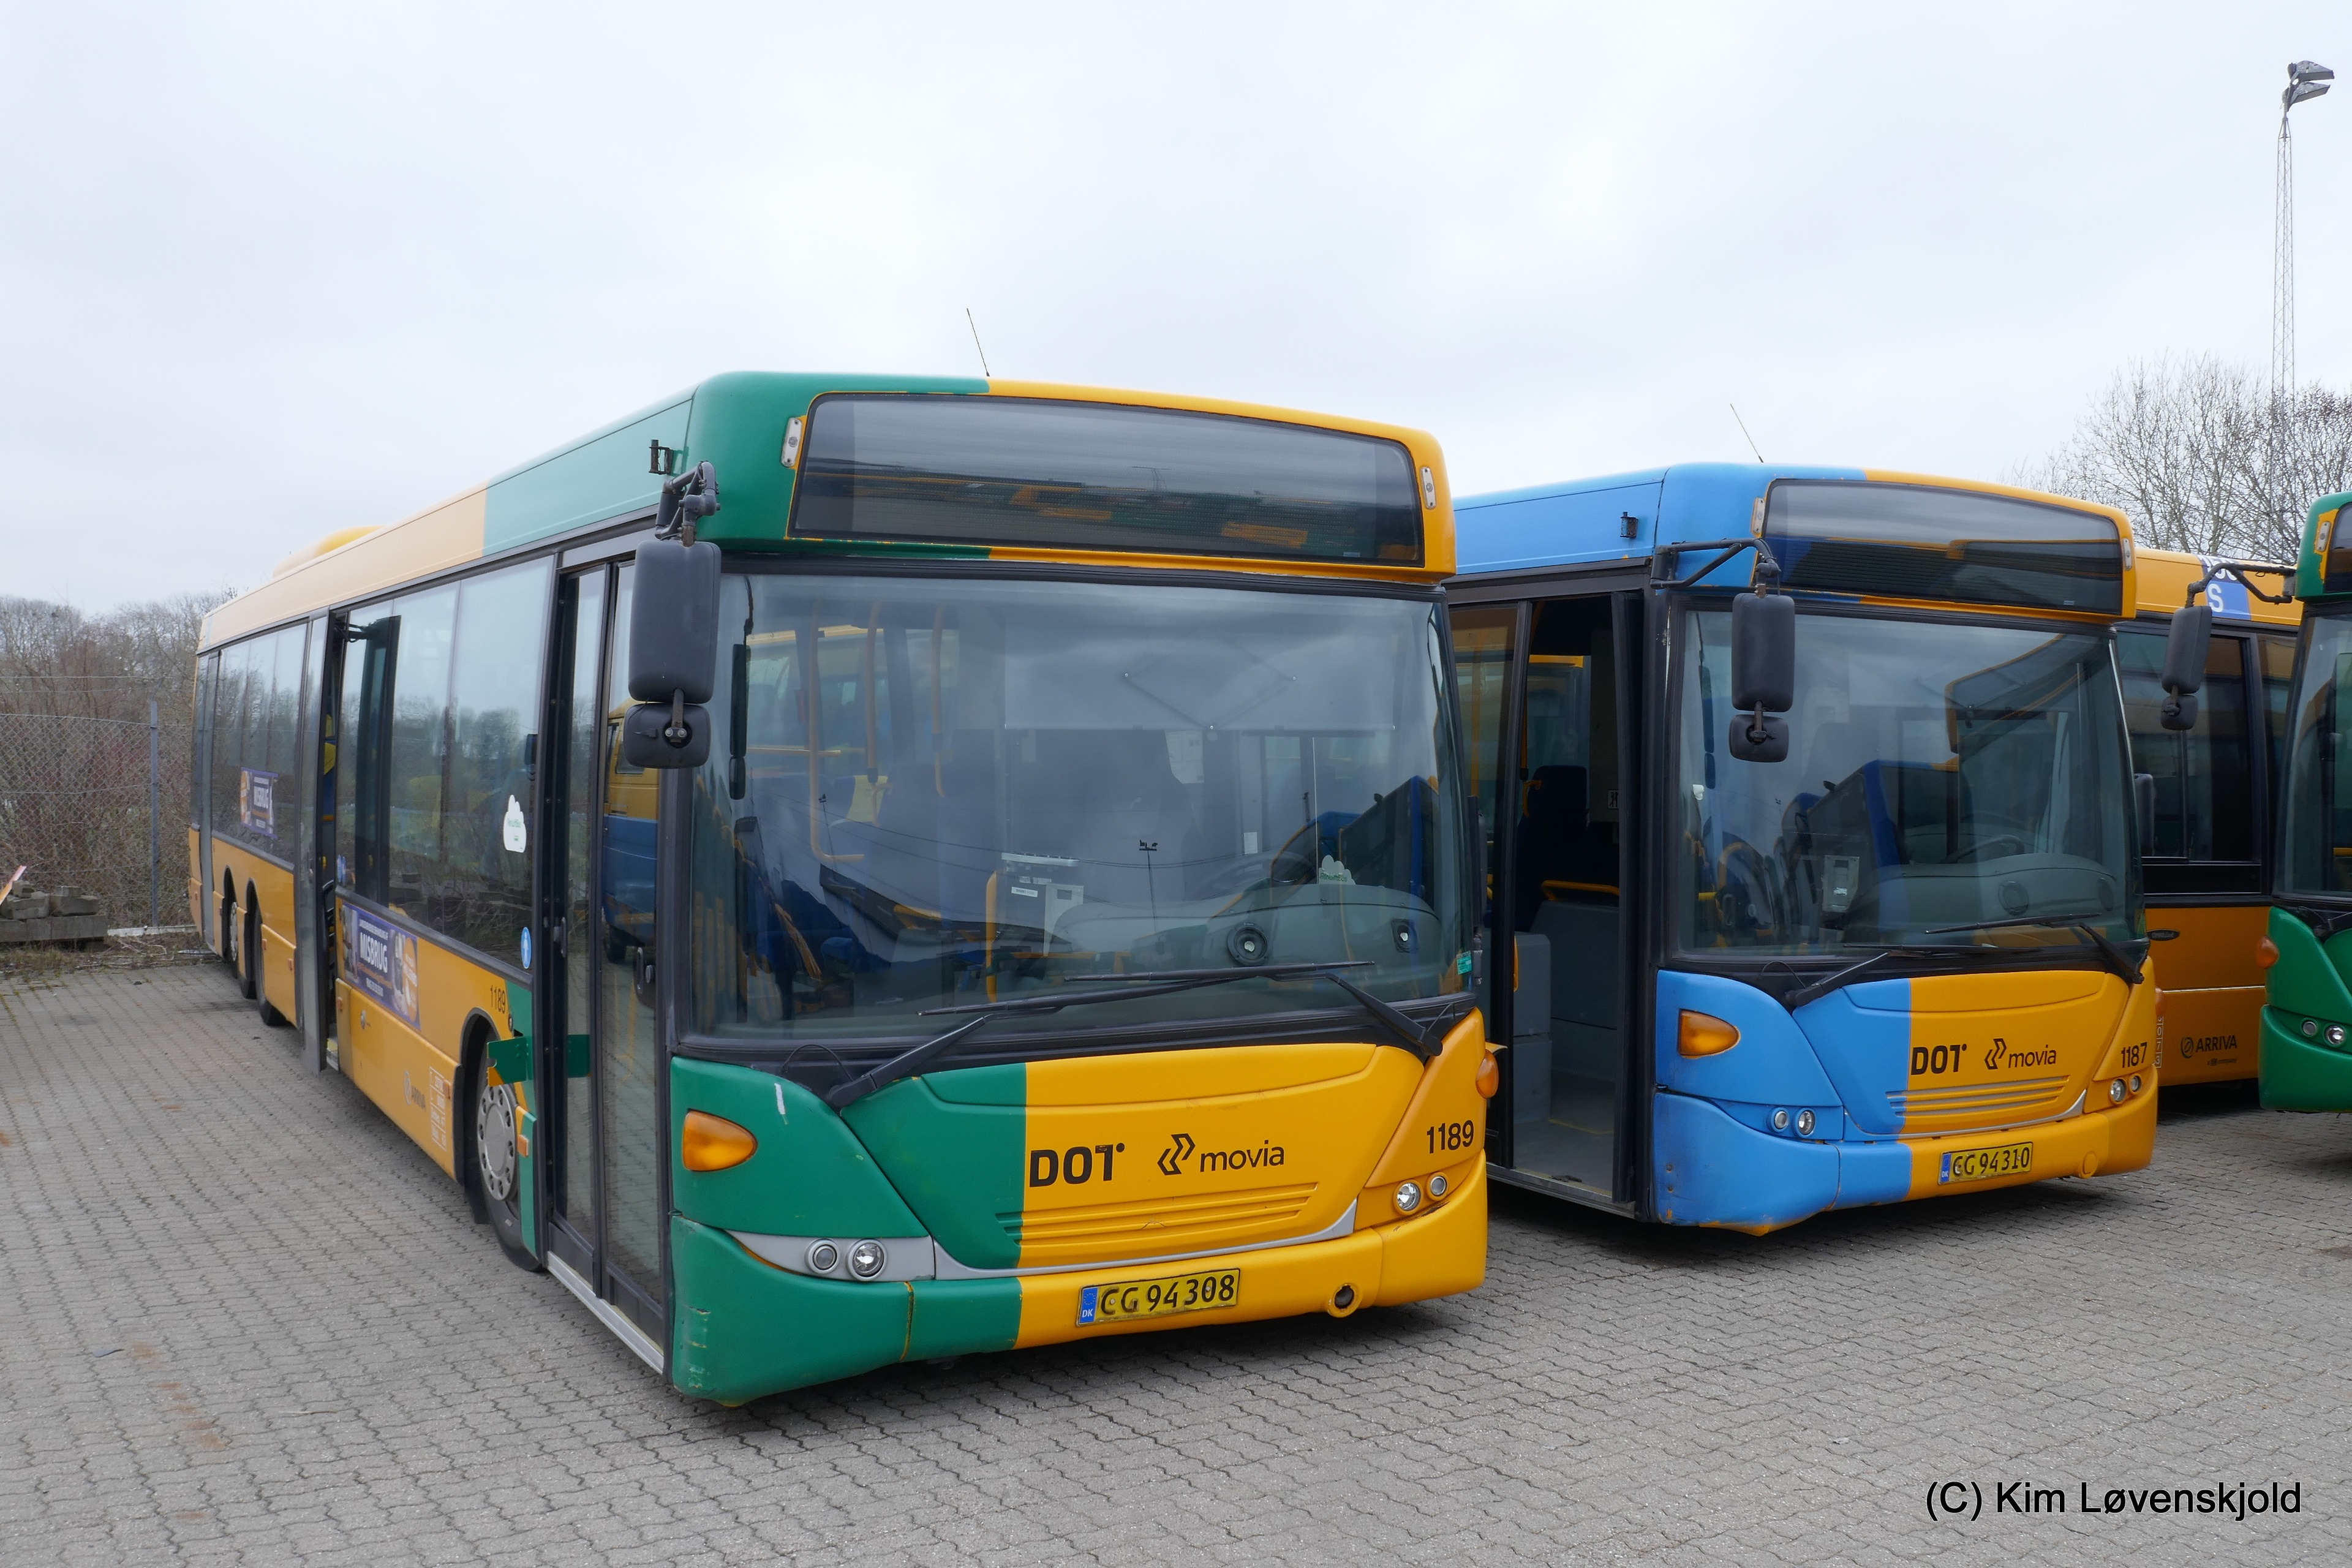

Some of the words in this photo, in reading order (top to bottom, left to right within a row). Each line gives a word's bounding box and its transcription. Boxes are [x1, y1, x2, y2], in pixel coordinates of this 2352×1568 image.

[2207, 583, 2224, 612] S
[360, 931, 388, 974] MISBRUG
[490, 984, 506, 1014] 1189
[2121, 1042, 2147, 1069] 1187
[2196, 1035, 2237, 1053] ARRIVA
[1910, 1043, 1967, 1075] DOT
[2008, 1044, 2056, 1069] movia
[1427, 1120, 1474, 1154] 1189
[1029, 1143, 1125, 1188] DOT
[1200, 1139, 1284, 1172] movia
[1082, 1308, 1093, 1318] DK
[1101, 1287, 1139, 1315] CG
